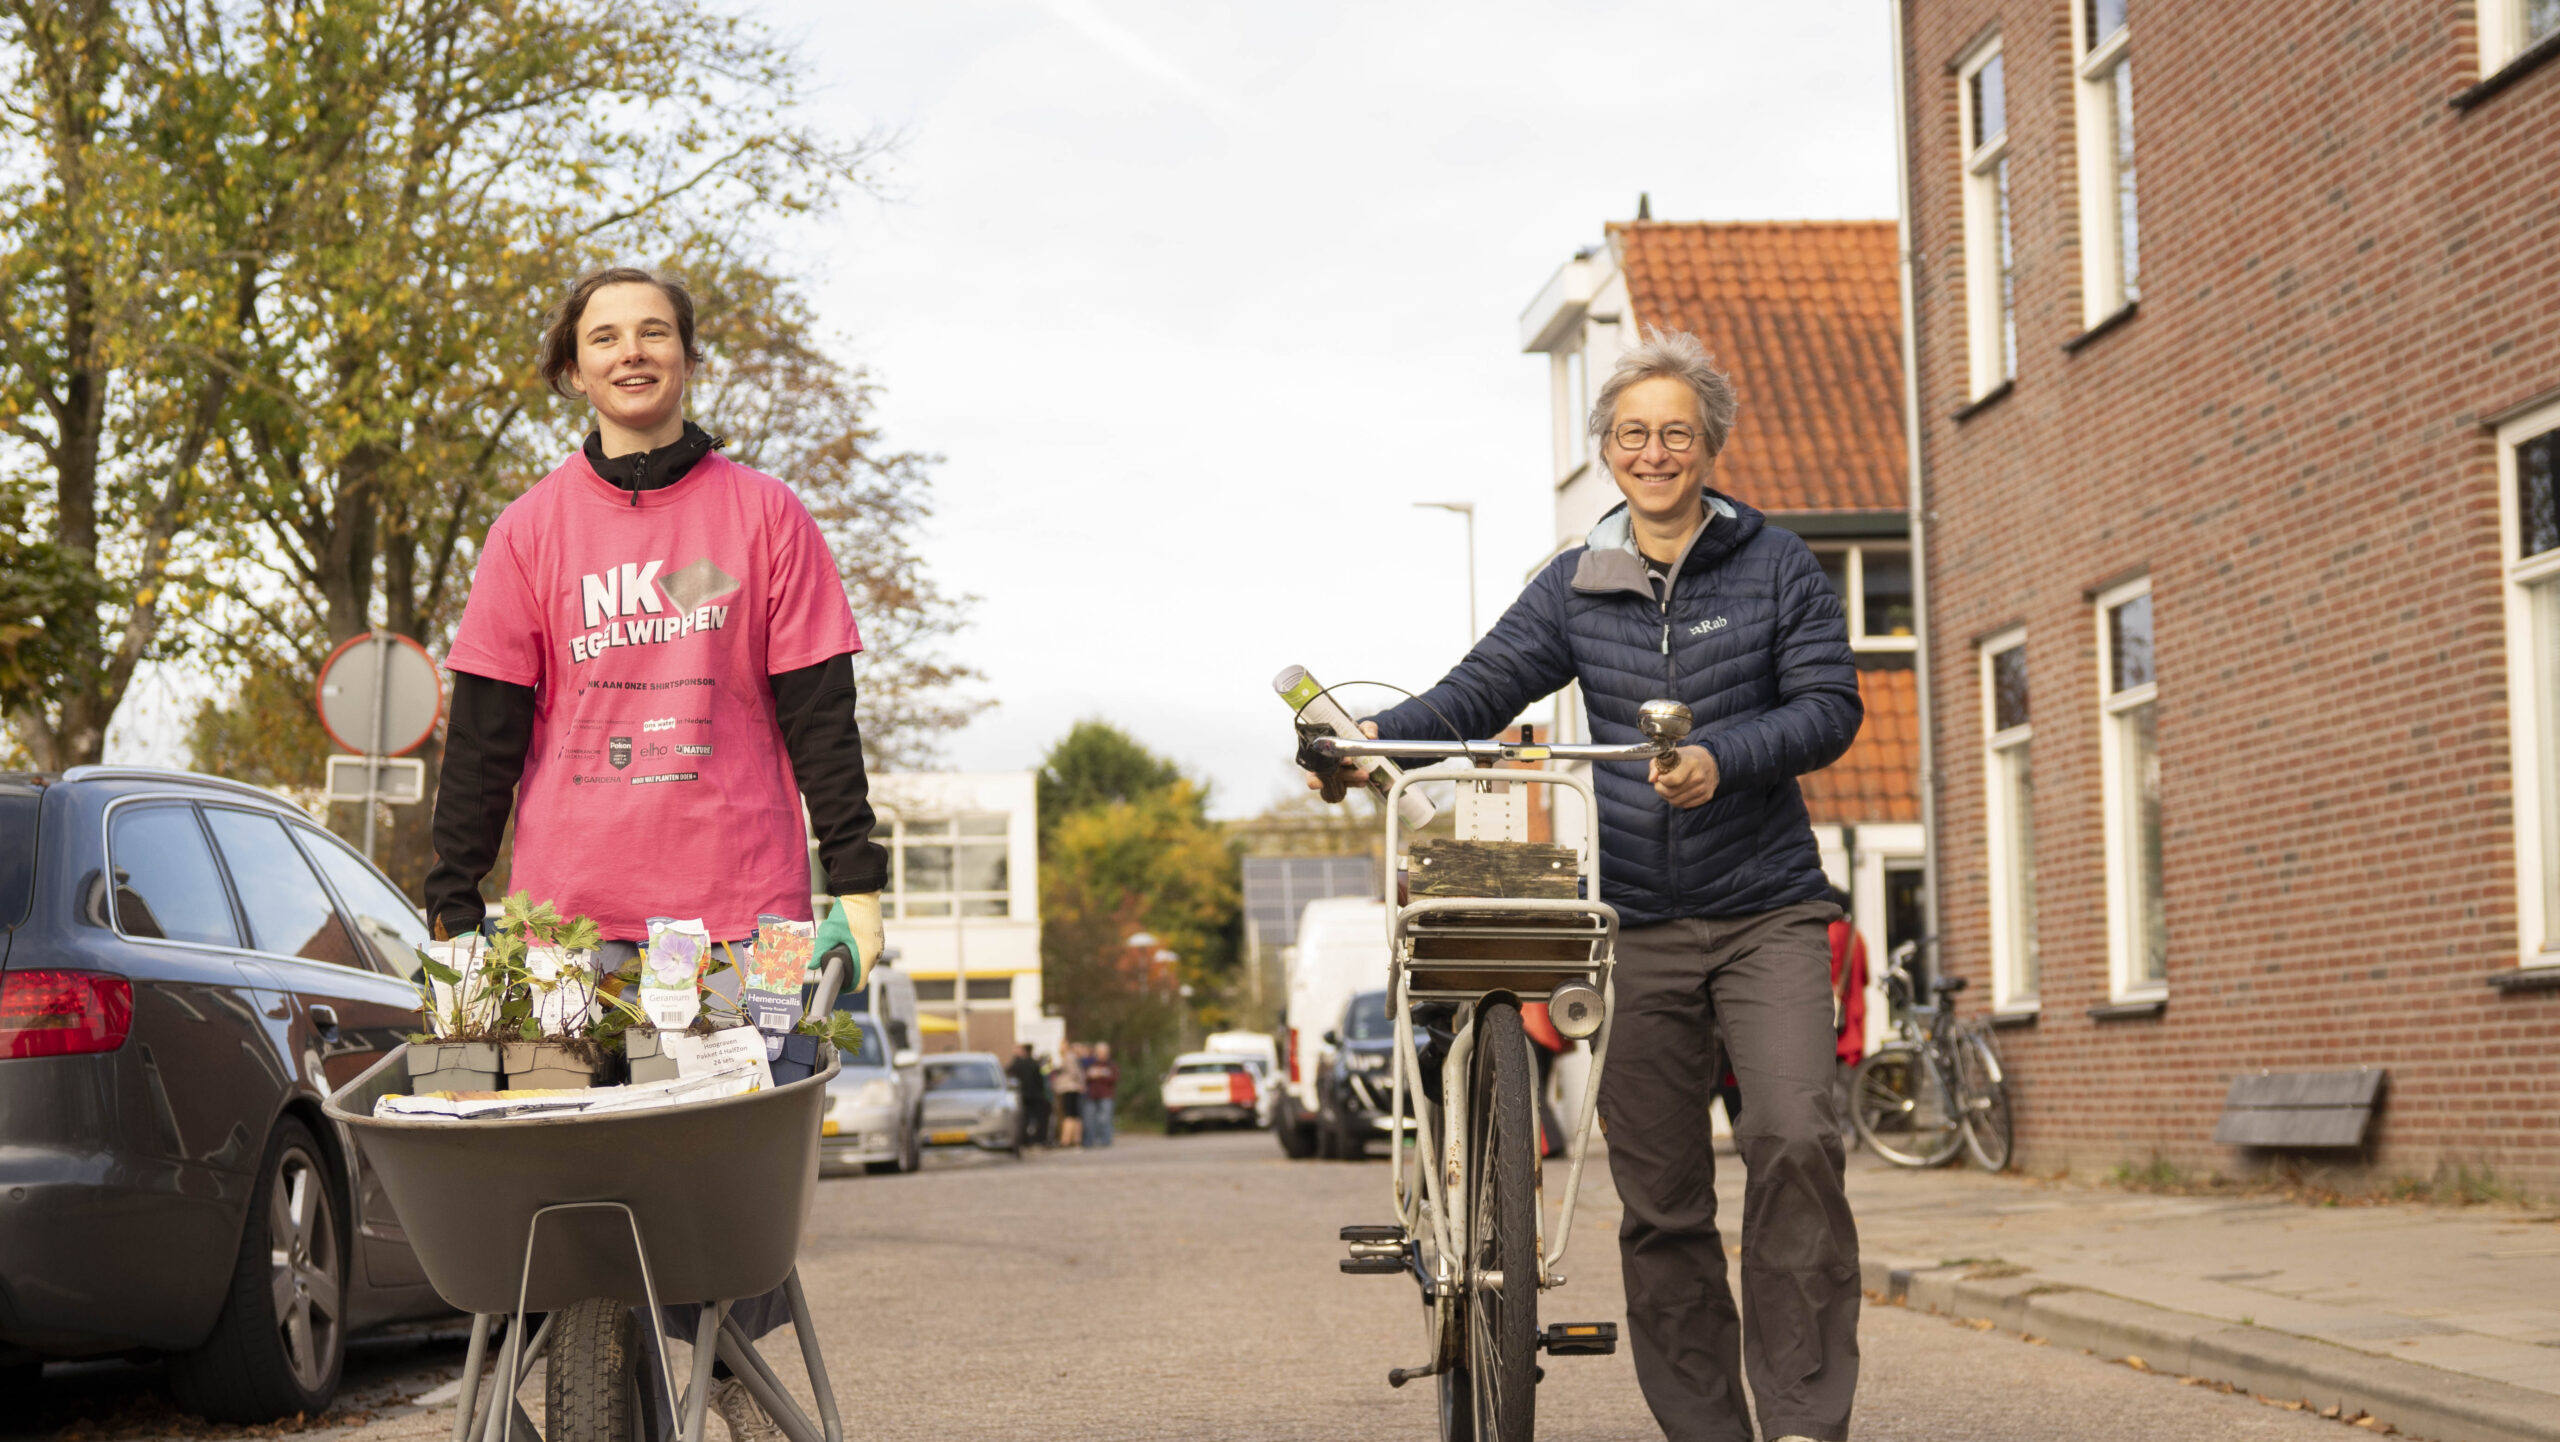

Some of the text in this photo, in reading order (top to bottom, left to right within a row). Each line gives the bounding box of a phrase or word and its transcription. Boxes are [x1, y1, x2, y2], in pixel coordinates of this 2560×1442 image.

[581, 560, 664, 629] NK
[1701, 616, 1727, 633] Rab
[568, 605, 728, 665] EGELWIPPEN
[602, 681, 623, 689] AAN
[624, 682, 648, 690] ONZE
[610, 742, 632, 750] Pokon
[640, 742, 668, 757] elho
[683, 745, 711, 755] NATURE
[584, 775, 622, 784] GARDENA
[655, 774, 680, 783] PLANTEN
[649, 992, 690, 1002] Geranium
[748, 993, 801, 1007] Hemerocallis
[704, 1039, 738, 1050] Hoograven
[696, 1051, 718, 1060] Pakket
[724, 1046, 748, 1055] HalfZon
